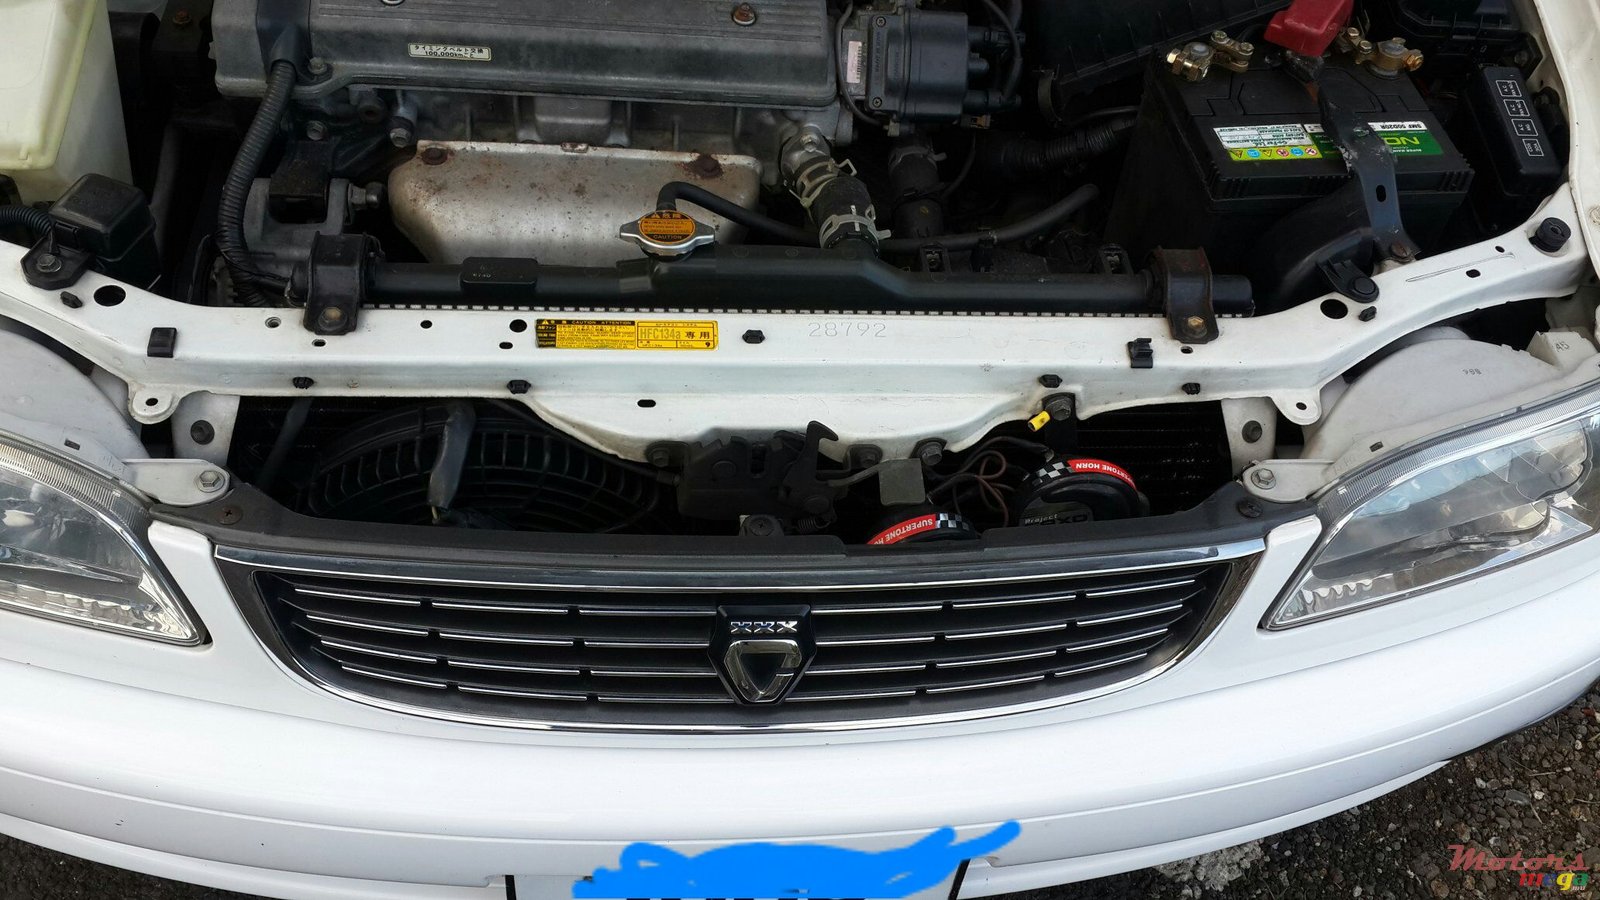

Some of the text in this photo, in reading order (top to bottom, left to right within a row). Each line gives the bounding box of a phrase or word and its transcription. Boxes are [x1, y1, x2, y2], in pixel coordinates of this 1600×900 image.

[640, 328, 681, 339] HFC134a
[808, 322, 887, 337] 28792
[886, 518, 933, 541] SUPERTONE
